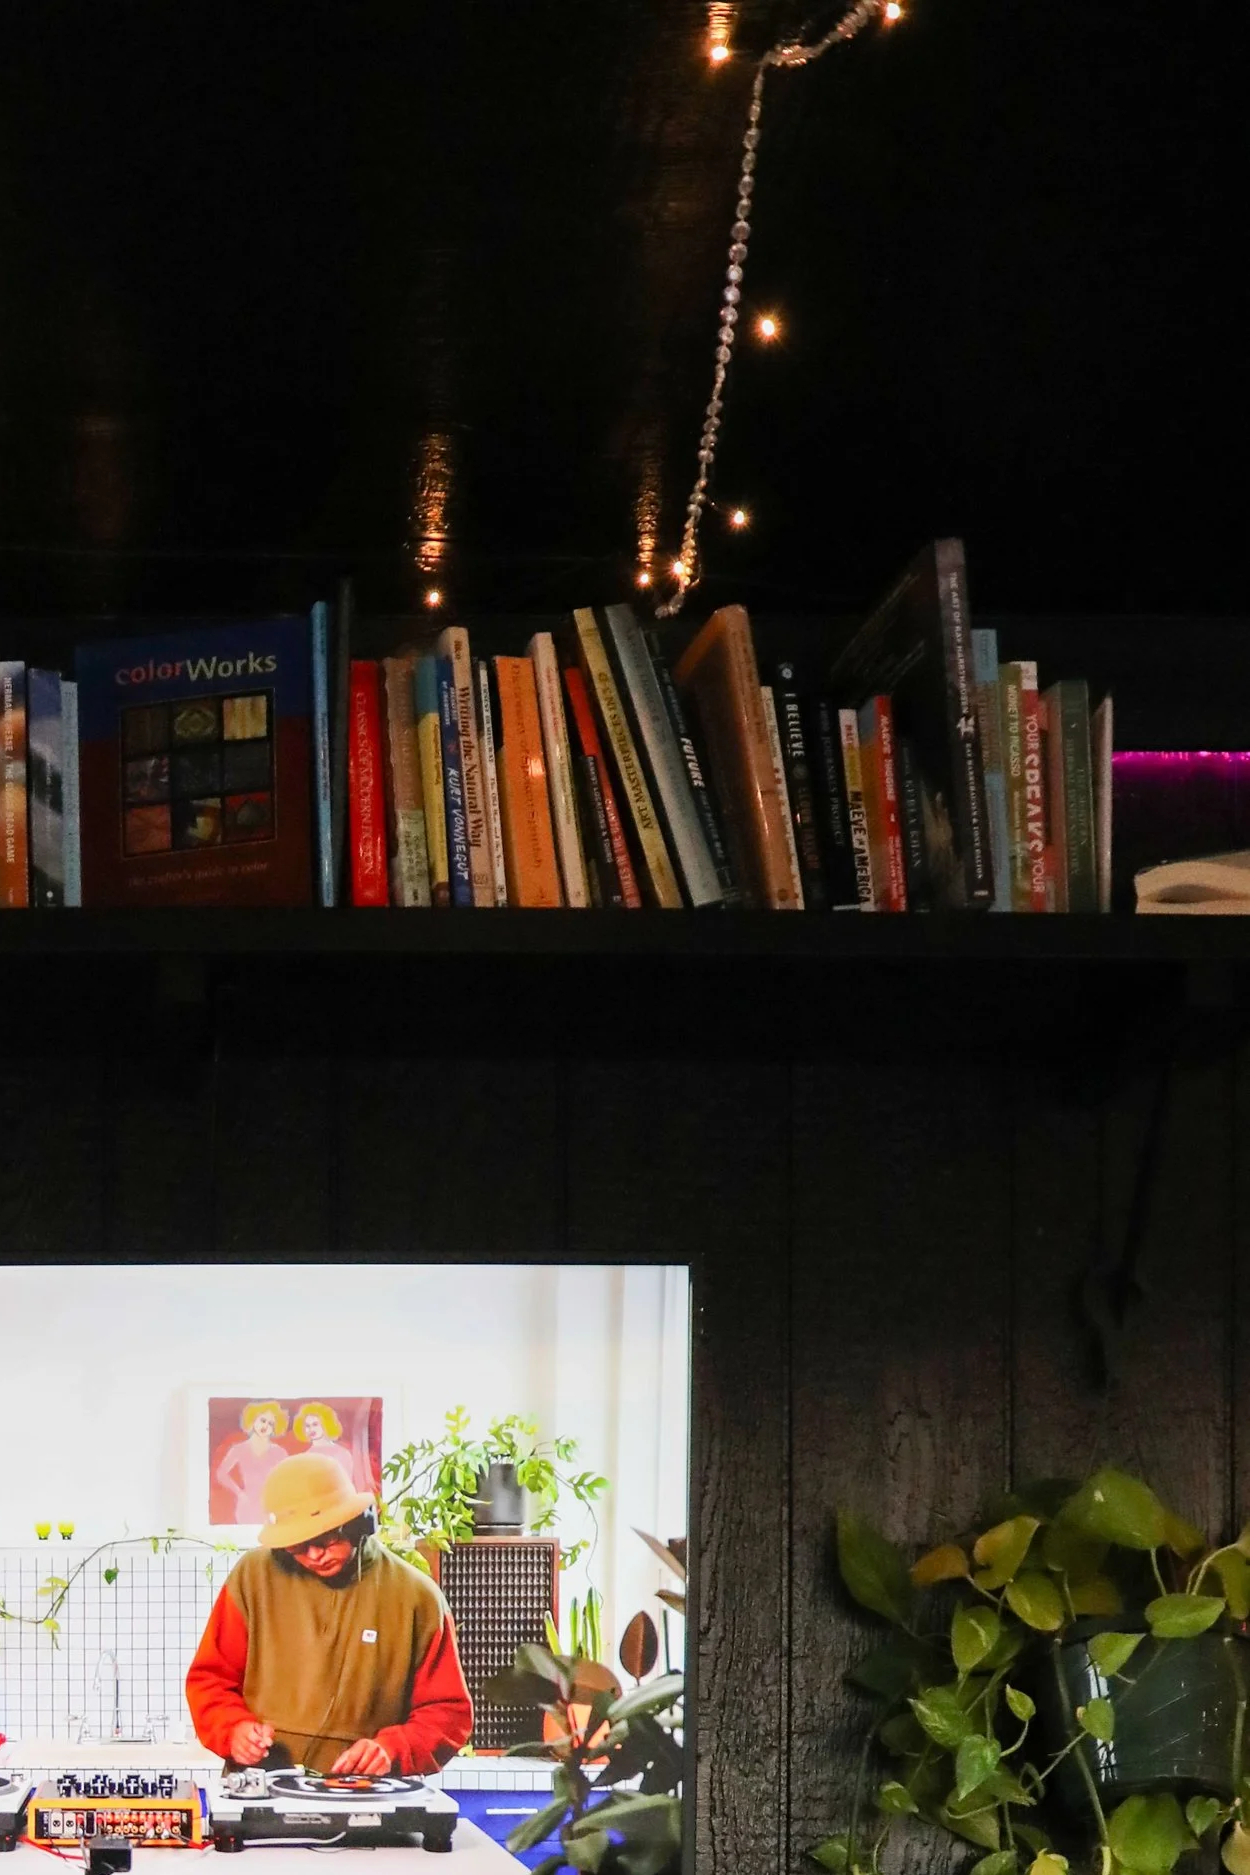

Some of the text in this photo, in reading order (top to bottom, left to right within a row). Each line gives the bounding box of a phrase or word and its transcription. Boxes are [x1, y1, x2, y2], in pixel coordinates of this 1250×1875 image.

[948, 572, 958, 589] THE
[950, 590, 959, 608] ART
[952, 610, 961, 623] OF
[953, 625, 963, 643] RAY
[355, 691, 368, 747] CLASSICS
[603, 694, 618, 713] IN
[1006, 684, 1018, 718] MONET
[785, 702, 805, 758] BELIEVE
[1008, 721, 1019, 733] TO
[1025, 714, 1039, 749] YOUR
[4, 763, 13, 779] THE
[454, 687, 484, 848] Writing the Natural Way
[609, 712, 645, 805] MASTERPIECES
[679, 734, 705, 790] FUTURE
[821, 735, 837, 794] JOURNALS
[359, 767, 373, 823] MODERN
[848, 790, 866, 835] MAEVE
[446, 766, 468, 880] KURT VONNEGUT
[592, 786, 606, 829] LOCATIONS
[602, 838, 613, 863] TOURS
[636, 805, 653, 831] ART
[828, 796, 843, 846] PROJECT
[5, 837, 14, 863] GAME
[908, 829, 922, 867] KHAN
[853, 846, 873, 903] AMERICA
[1031, 857, 1045, 893] YOUR
